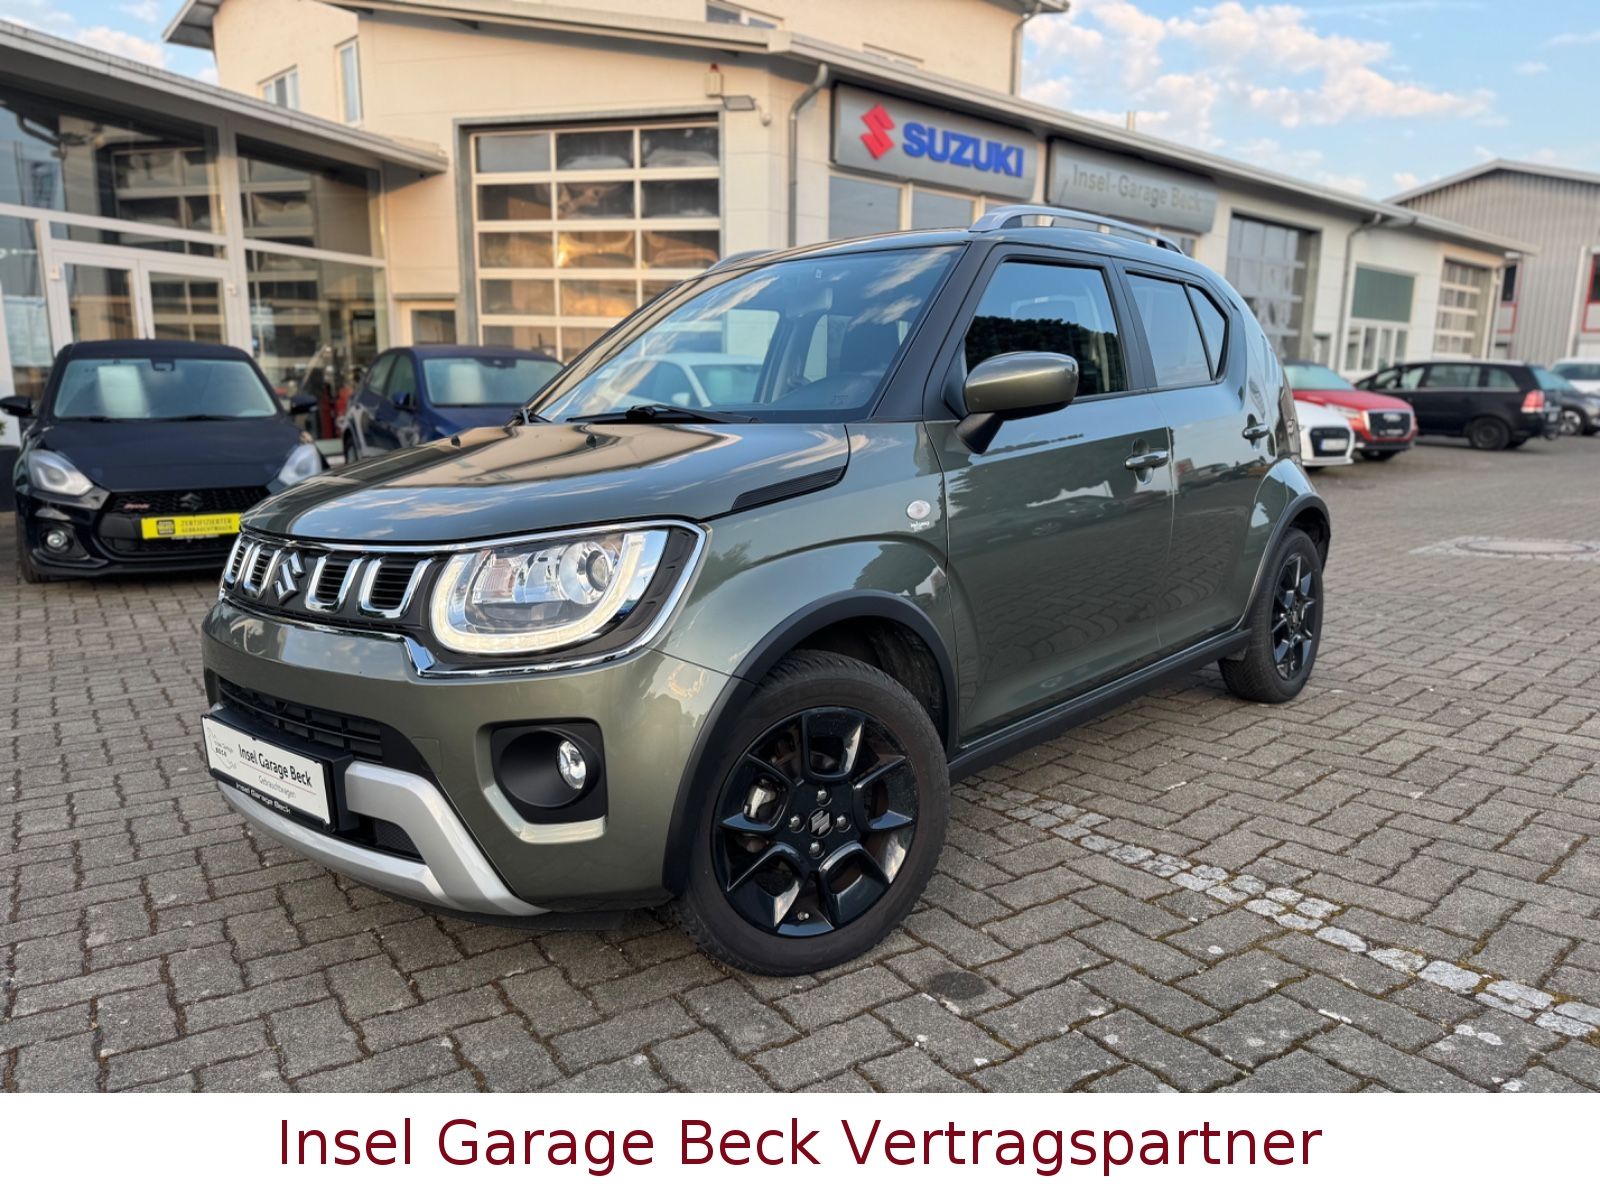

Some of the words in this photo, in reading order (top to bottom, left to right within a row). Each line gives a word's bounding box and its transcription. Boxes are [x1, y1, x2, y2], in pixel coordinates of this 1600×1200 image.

[902, 121, 1024, 178] SUZUKI
[1072, 164, 1168, 208] Insel-Garage
[238, 744, 258, 765] Insel
[258, 752, 289, 779] Garage
[289, 765, 313, 788] Beck
[235, 782, 251, 794] Insel
[250, 789, 273, 805] Garage
[273, 800, 291, 814] Beck
